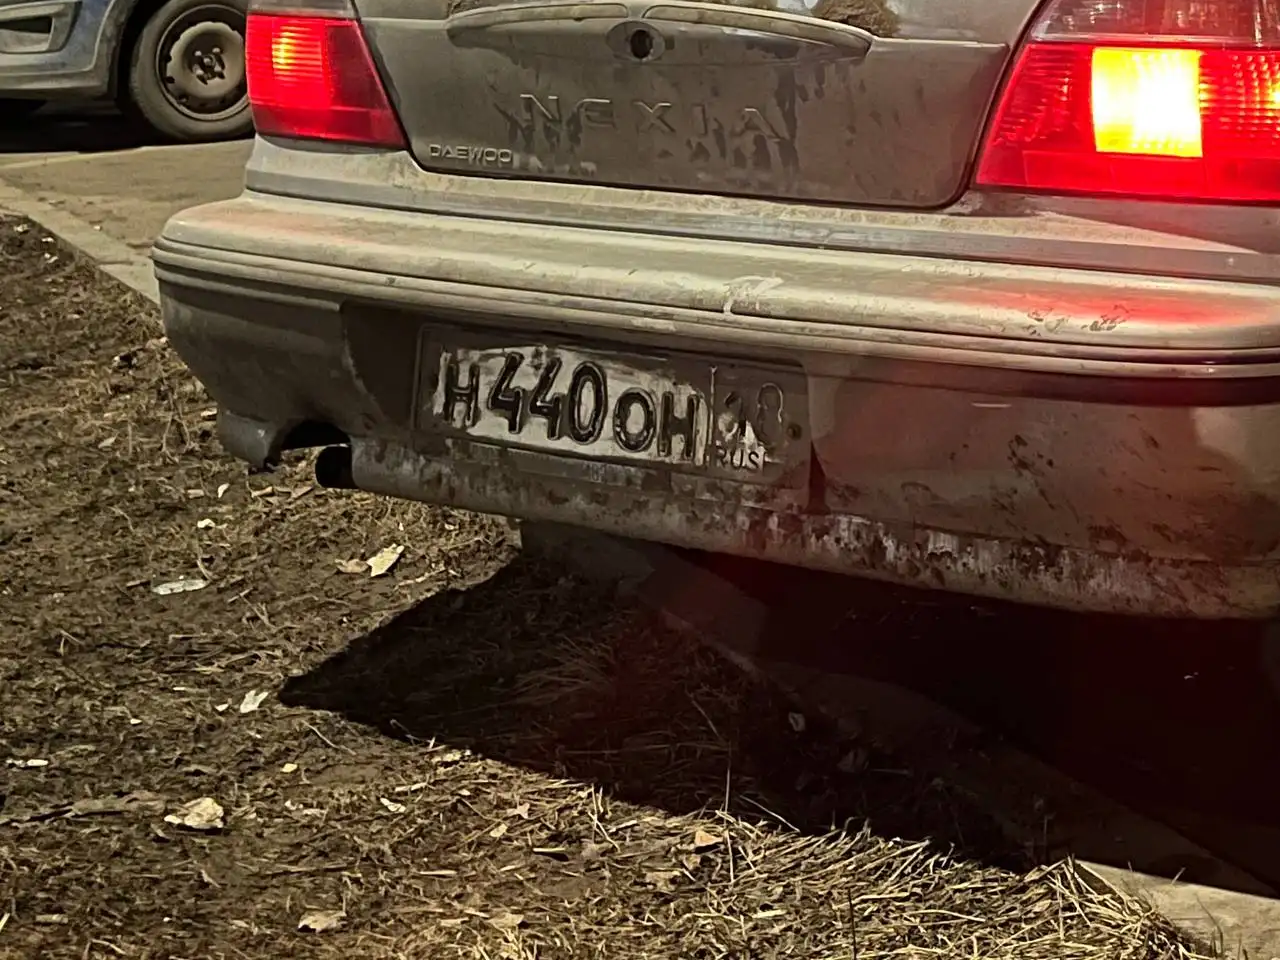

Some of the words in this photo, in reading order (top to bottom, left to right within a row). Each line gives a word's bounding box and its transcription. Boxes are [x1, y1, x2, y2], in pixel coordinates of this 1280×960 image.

[519, 93, 784, 141] NEXIA
[429, 143, 513, 163] DAEWOO
[714, 443, 761, 471] RUS
